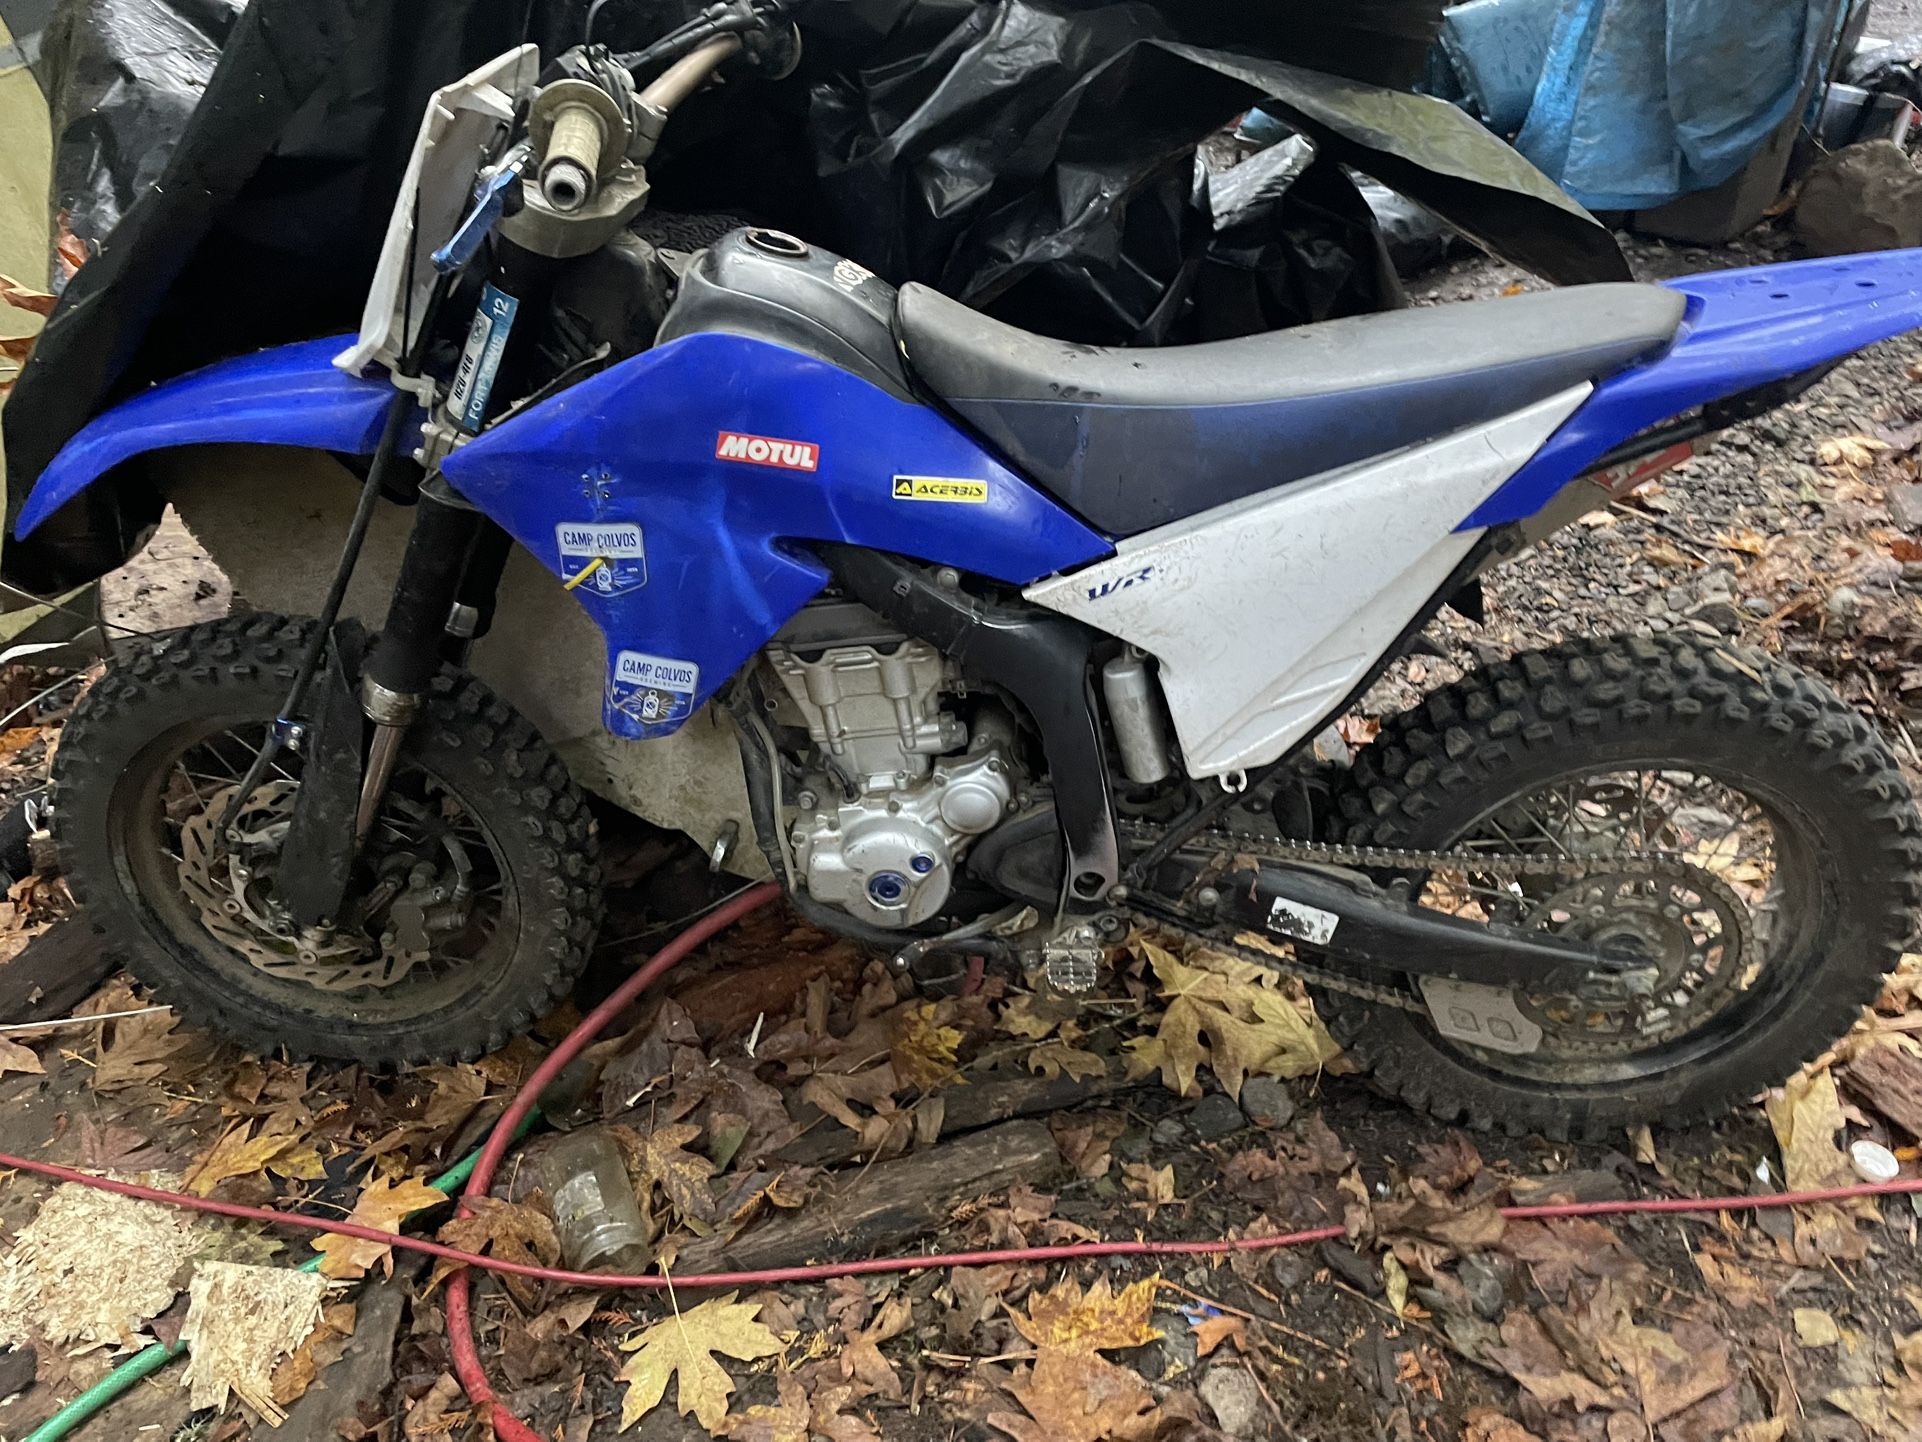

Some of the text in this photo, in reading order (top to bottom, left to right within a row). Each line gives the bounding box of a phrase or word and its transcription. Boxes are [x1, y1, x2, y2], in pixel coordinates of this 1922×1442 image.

[493, 297, 510, 317] 12
[468, 384, 489, 420] FORT
[718, 435, 815, 468] MOTUL
[916, 484, 983, 496] ACERBIS
[563, 531, 637, 548] CAMP COLVOS
[623, 659, 692, 684] CAMP COLVOS
